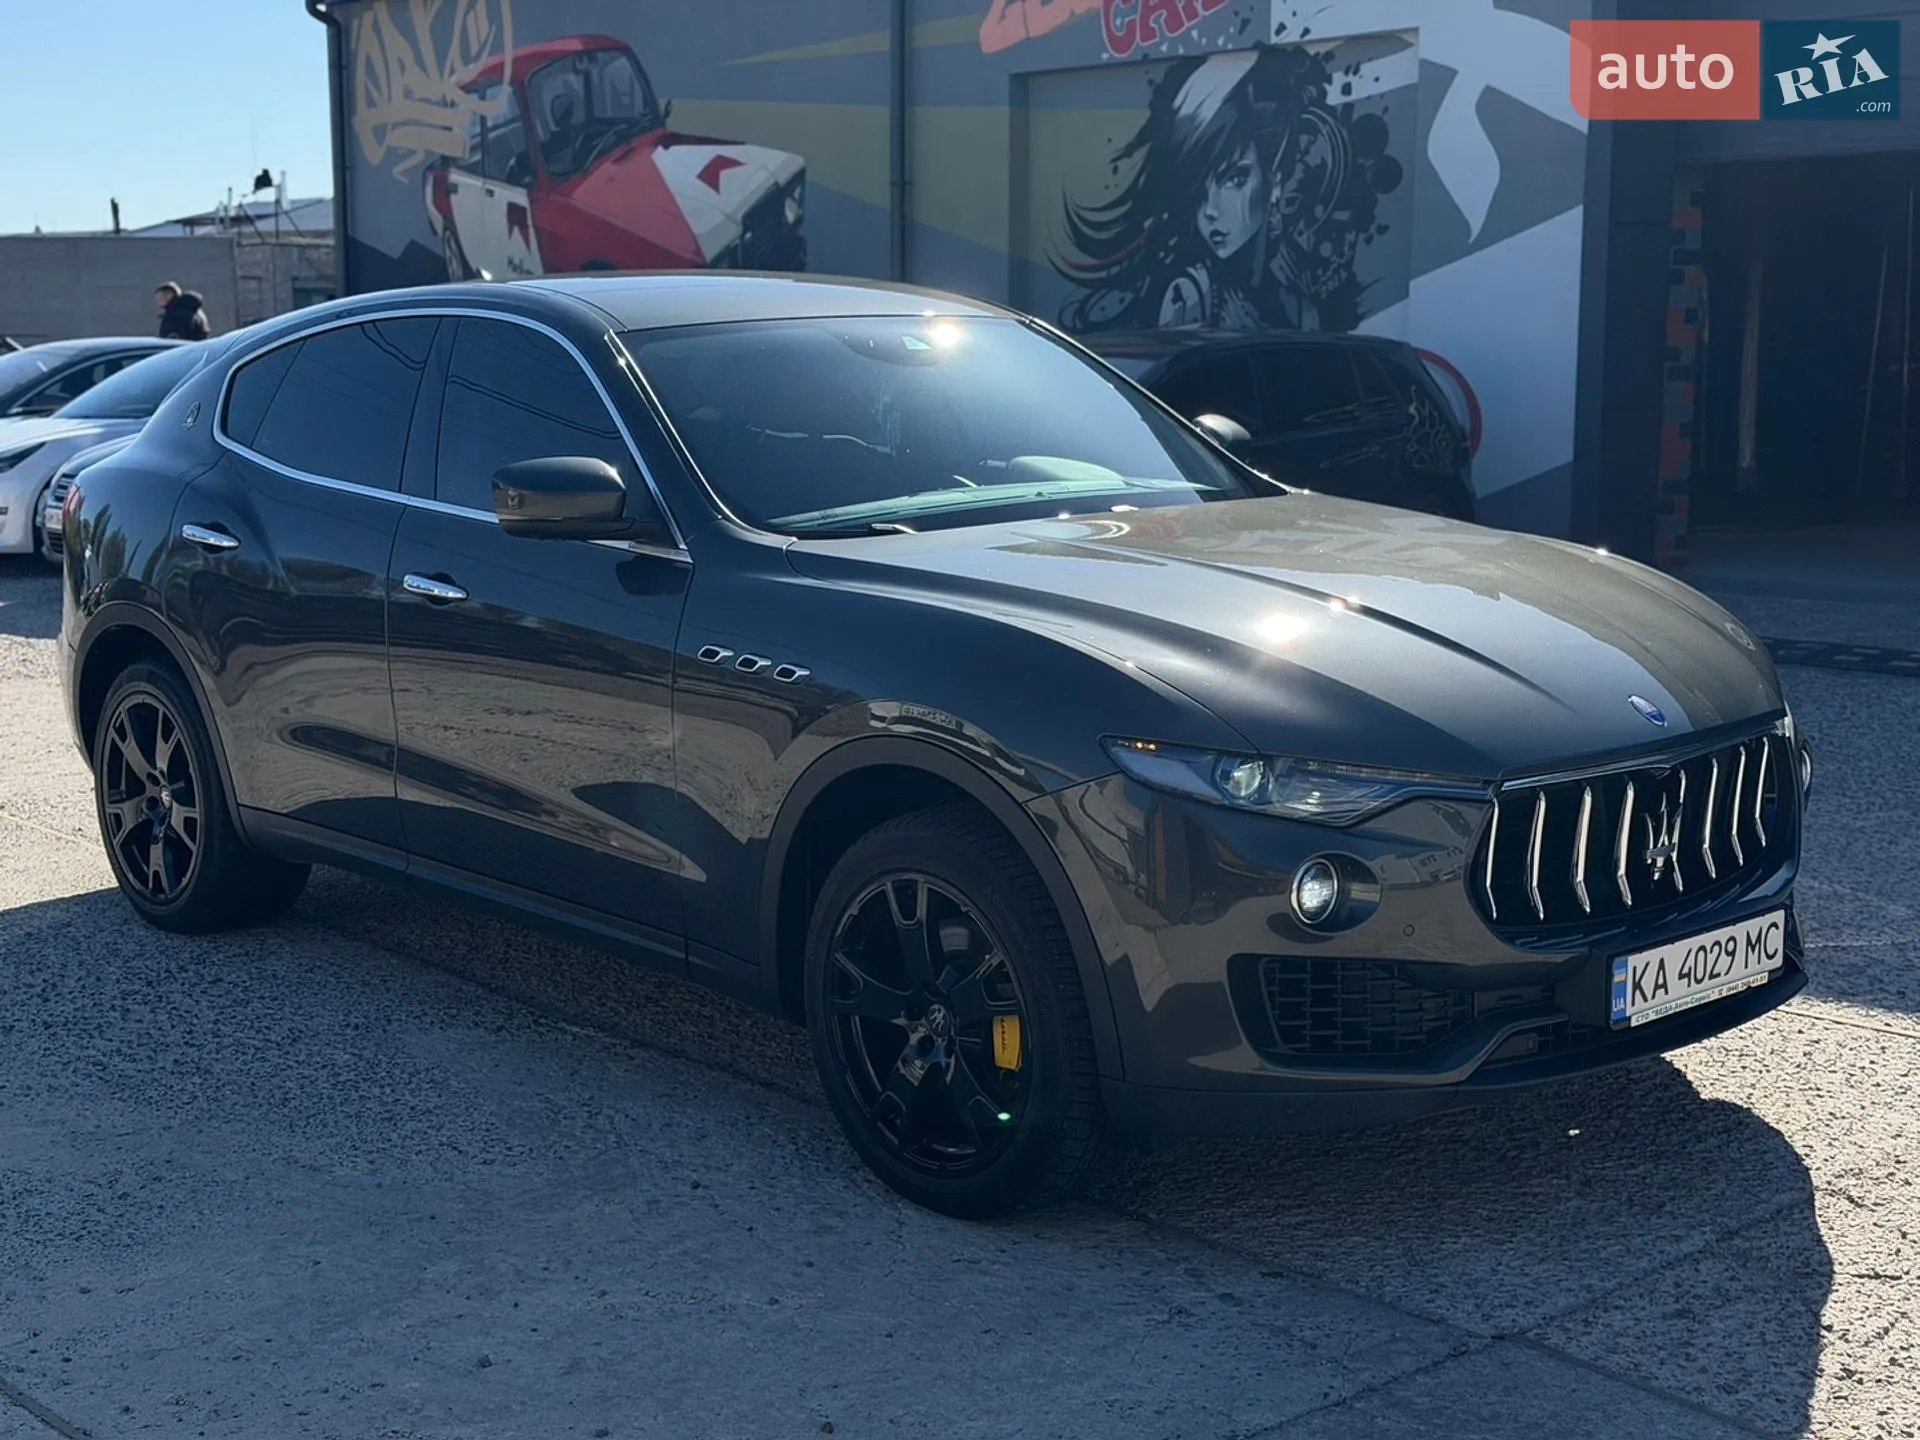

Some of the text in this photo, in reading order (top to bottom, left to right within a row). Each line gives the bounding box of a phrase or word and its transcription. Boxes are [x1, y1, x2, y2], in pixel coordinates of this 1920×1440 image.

[1631, 922, 1780, 1007] KA 4029 MC
[1612, 997, 1625, 1012] UA
